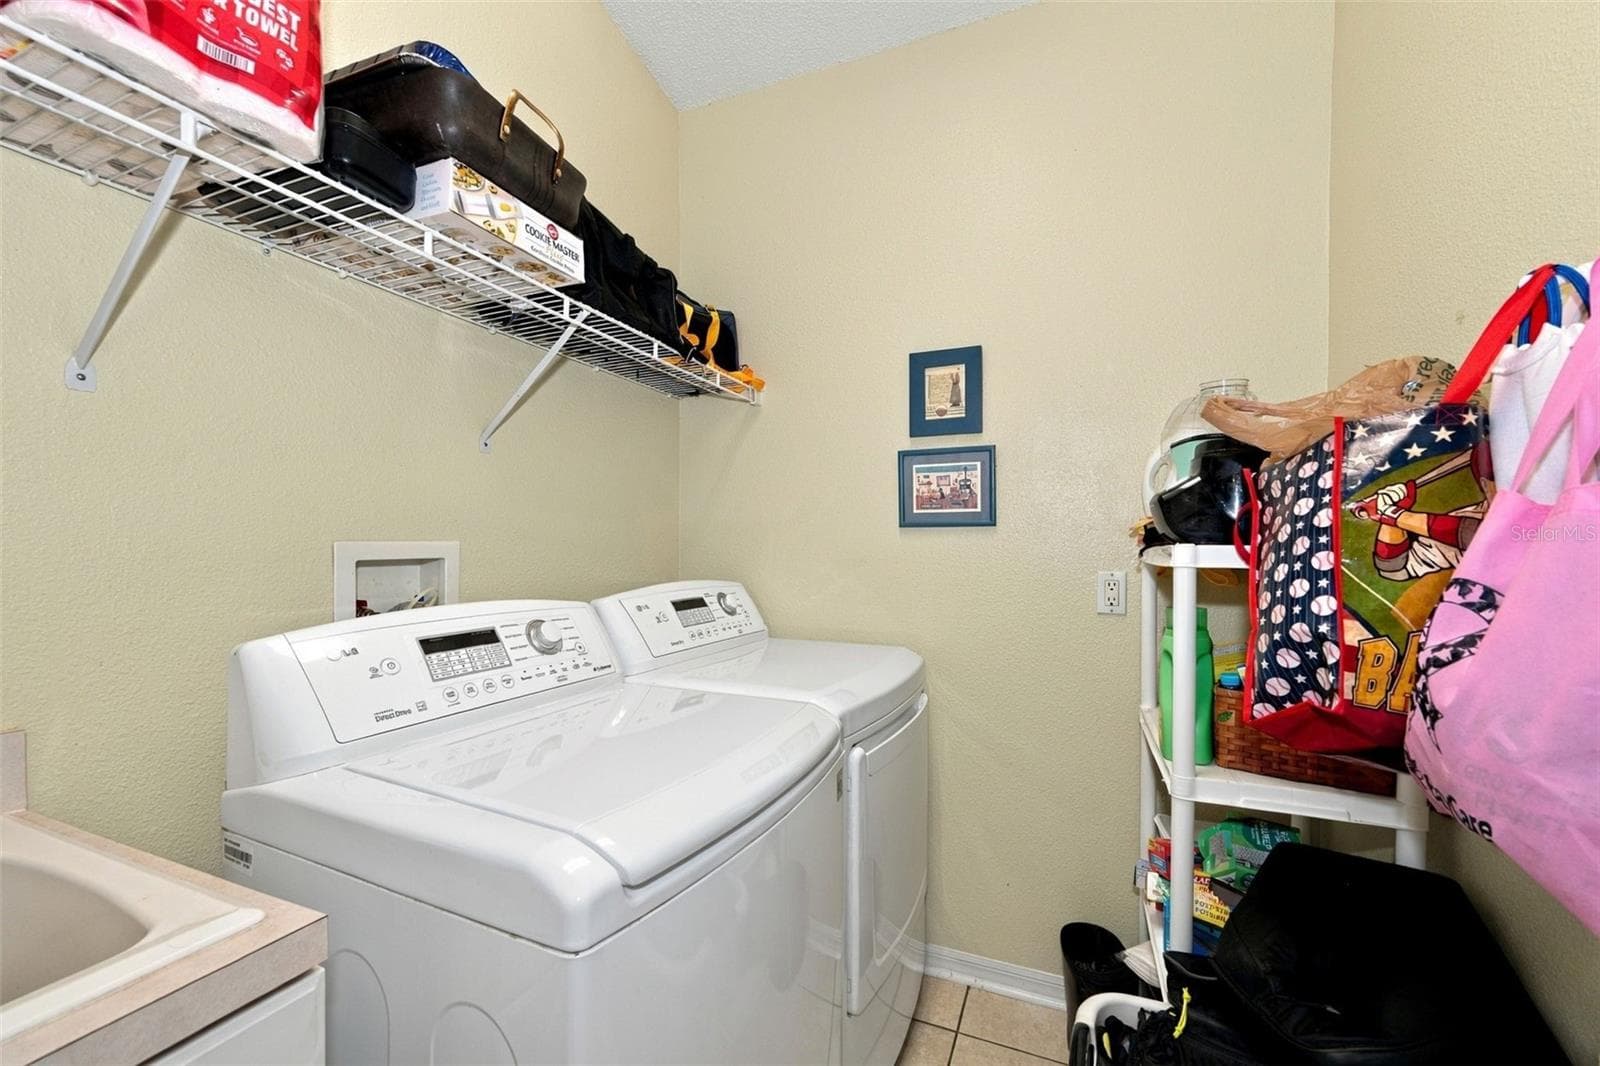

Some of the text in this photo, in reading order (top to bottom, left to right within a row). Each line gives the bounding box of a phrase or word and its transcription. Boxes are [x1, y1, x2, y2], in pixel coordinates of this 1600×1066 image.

[233, 0, 299, 52] TOWEL
[525, 224, 552, 246] COOKIE
[552, 240, 580, 263] MASTER
